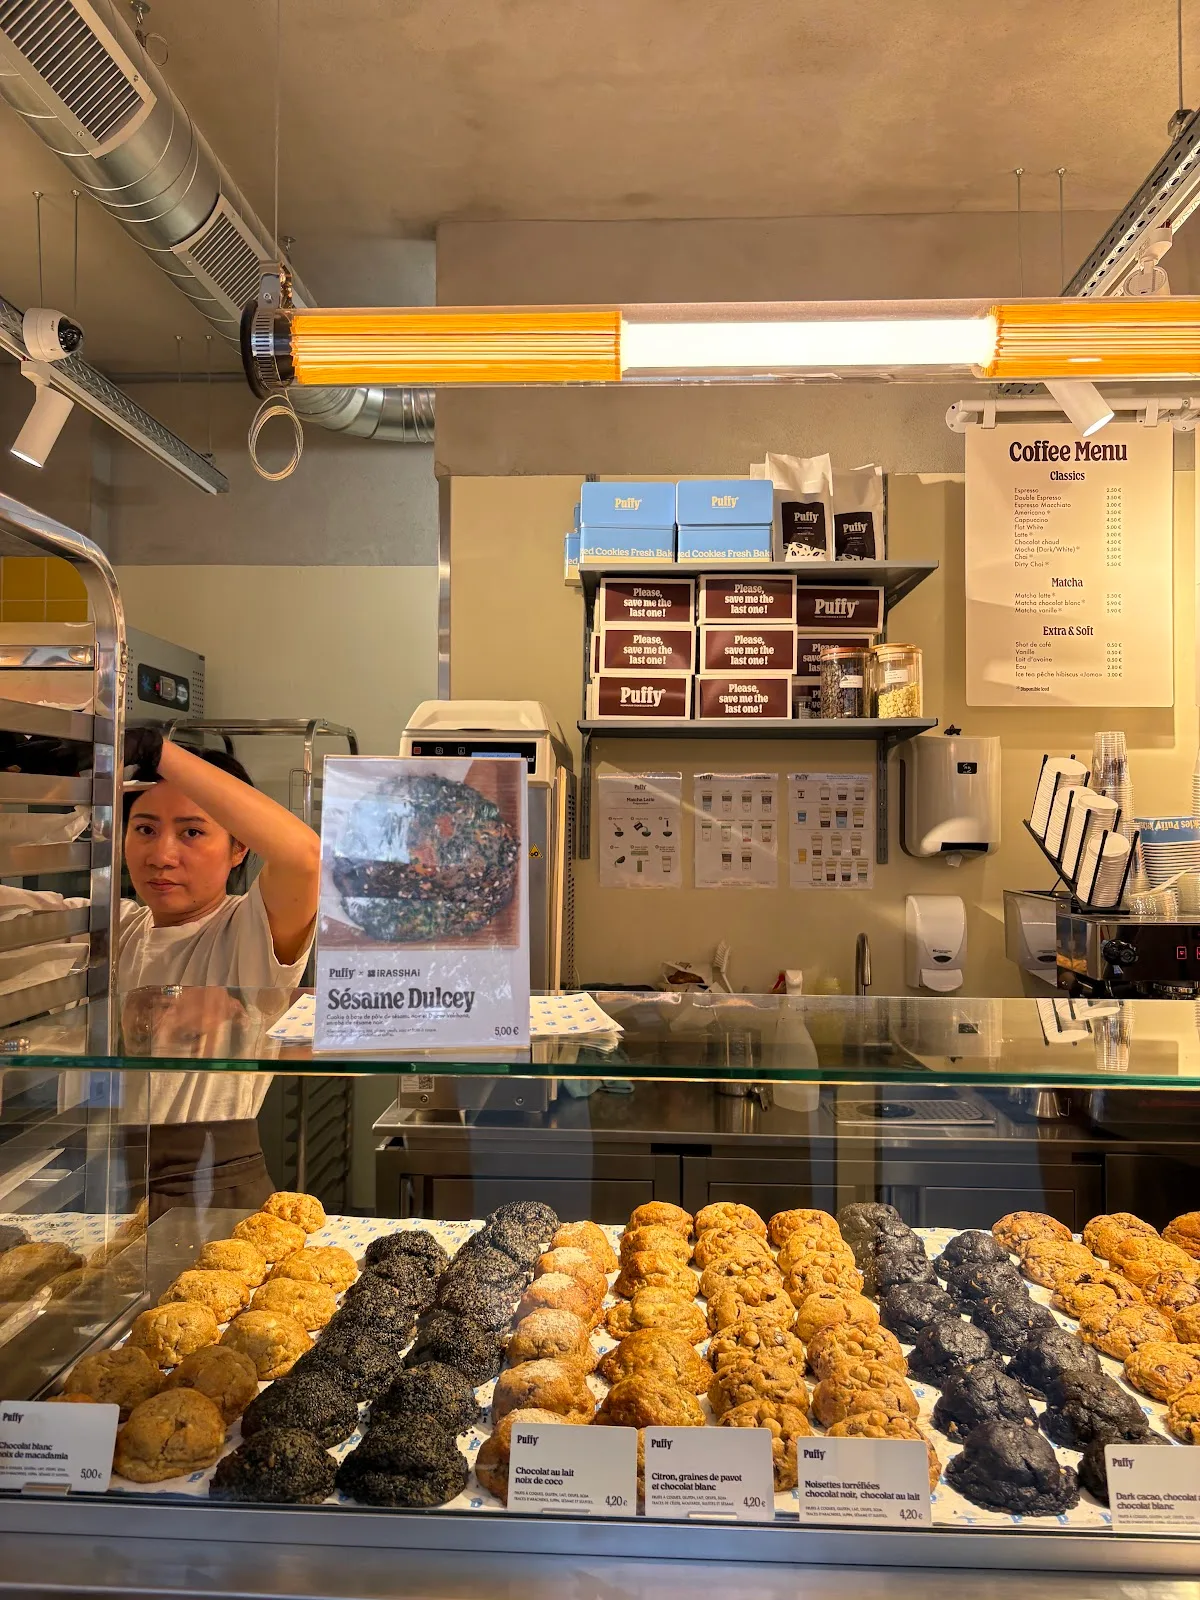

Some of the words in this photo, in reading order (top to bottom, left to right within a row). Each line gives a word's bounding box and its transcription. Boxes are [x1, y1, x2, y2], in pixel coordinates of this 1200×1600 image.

[1009, 441, 1070, 462] Coffee
[1075, 441, 1127, 462] Menu
[1050, 471, 1085, 480] Classics
[615, 498, 640, 510] Puffy
[711, 496, 737, 508] Puffy
[794, 512, 818, 523] Puffy
[843, 522, 867, 533] Puffy
[596, 548, 629, 557] Cookies
[631, 549, 654, 557] Fresh
[692, 550, 725, 558] Cookies
[727, 550, 751, 558] Fresh
[753, 550, 771, 558] Bak
[1052, 578, 1083, 587] Matcha
[633, 588, 662, 598] Please,
[734, 584, 764, 594] Please,
[658, 598, 671, 607] the
[725, 595, 743, 603] save
[760, 594, 774, 603] the
[630, 608, 645, 617] last
[731, 605, 746, 613] last
[814, 598, 856, 618] Puffy
[1043, 626, 1067, 636] Extra
[1068, 626, 1074, 636] &
[1076, 626, 1093, 636] Soft
[633, 635, 663, 645] Please,
[734, 635, 765, 645] Please,
[658, 645, 672, 654] the
[760, 646, 774, 654] the
[630, 655, 645, 664] last
[731, 656, 746, 664] last
[729, 684, 759, 694] Please,
[620, 686, 662, 707] Puffy
[719, 695, 738, 703] save
[739, 695, 753, 703] me
[754, 694, 768, 703] the
[725, 704, 741, 713] last
[329, 968, 354, 979] Puffy
[328, 988, 404, 1010] Sésame
[408, 987, 475, 1012] Dulcey
[3, 1412, 22, 1423] Puffy
[517, 1435, 538, 1446] Puffy
[651, 1438, 673, 1450] Puffy
[0, 1442, 31, 1450] Chocolat
[25, 1451, 68, 1460] macadamia
[803, 1449, 825, 1460] Puffy
[1112, 1458, 1133, 1469] Puffy
[516, 1467, 550, 1476] Chocolat
[561, 1468, 574, 1477] lait
[515, 1476, 532, 1485] noix
[533, 1477, 543, 1485] de
[652, 1472, 677, 1481] Citron,
[678, 1473, 708, 1482] graines
[709, 1473, 719, 1481] de
[721, 1474, 742, 1483] pavot
[660, 1482, 693, 1490] chocolat
[695, 1483, 716, 1491] blanc
[805, 1480, 840, 1489] Noisettes
[842, 1481, 880, 1490] torréfiées
[805, 1490, 838, 1498] chocolat
[840, 1491, 858, 1500] noir,
[860, 1491, 894, 1500] chocolat
[907, 1492, 920, 1501] lait
[1163, 1493, 1197, 1501] chocolat
